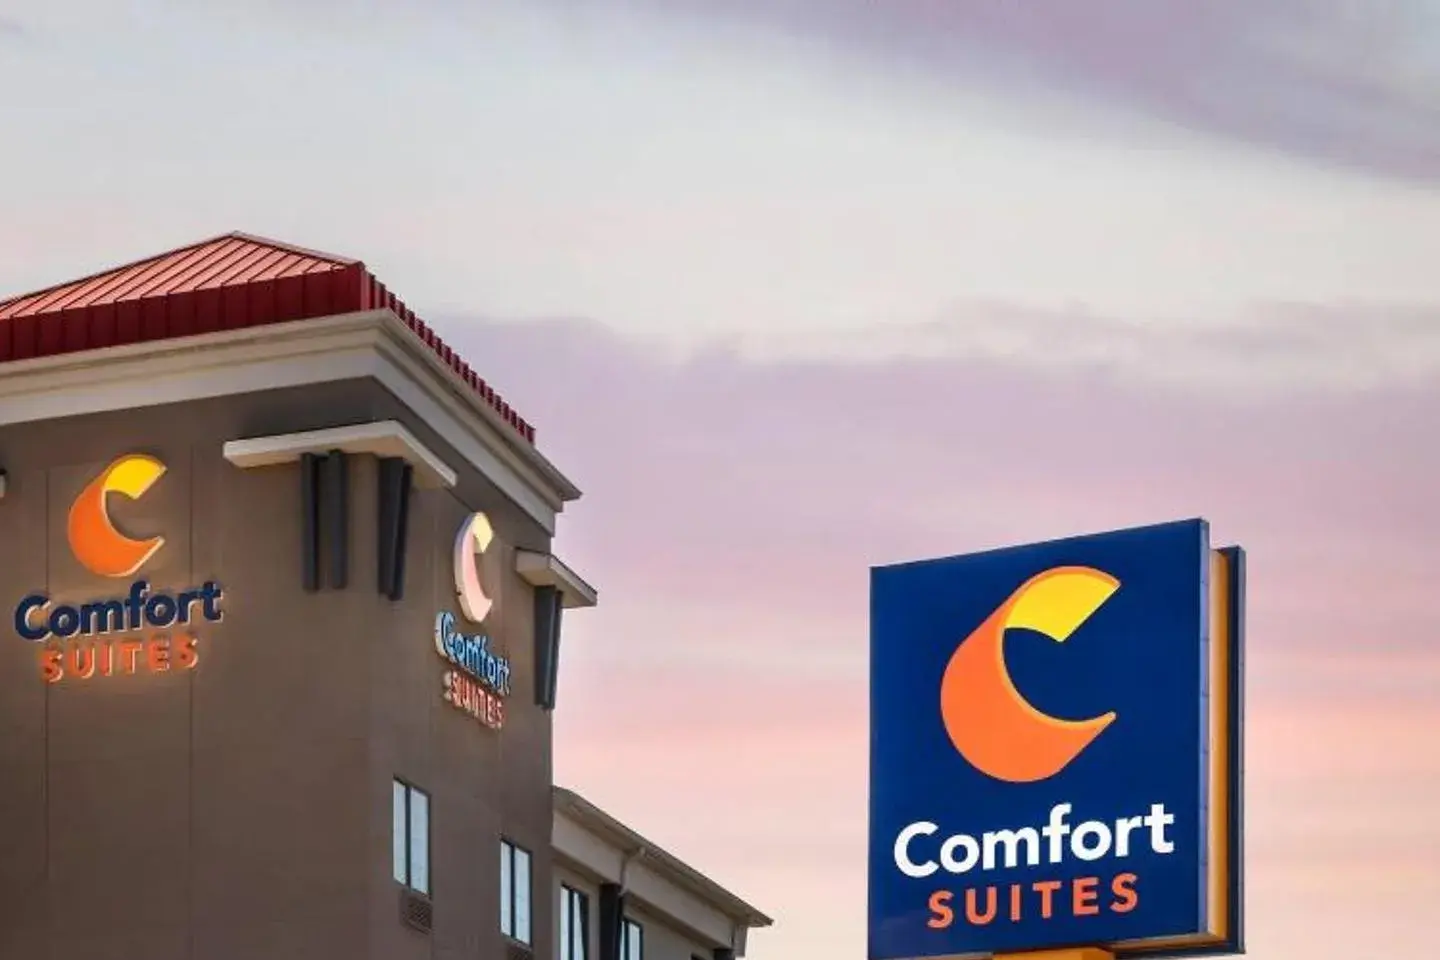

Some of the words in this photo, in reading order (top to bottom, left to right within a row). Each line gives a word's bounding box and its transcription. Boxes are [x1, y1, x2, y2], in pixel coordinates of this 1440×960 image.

[15, 580, 224, 642] Comfort
[40, 634, 198, 683] SUITES
[435, 611, 510, 697] Comfort
[444, 669, 504, 730] SUITES
[893, 803, 1176, 878] Comfort
[926, 872, 1139, 929] SUITES
